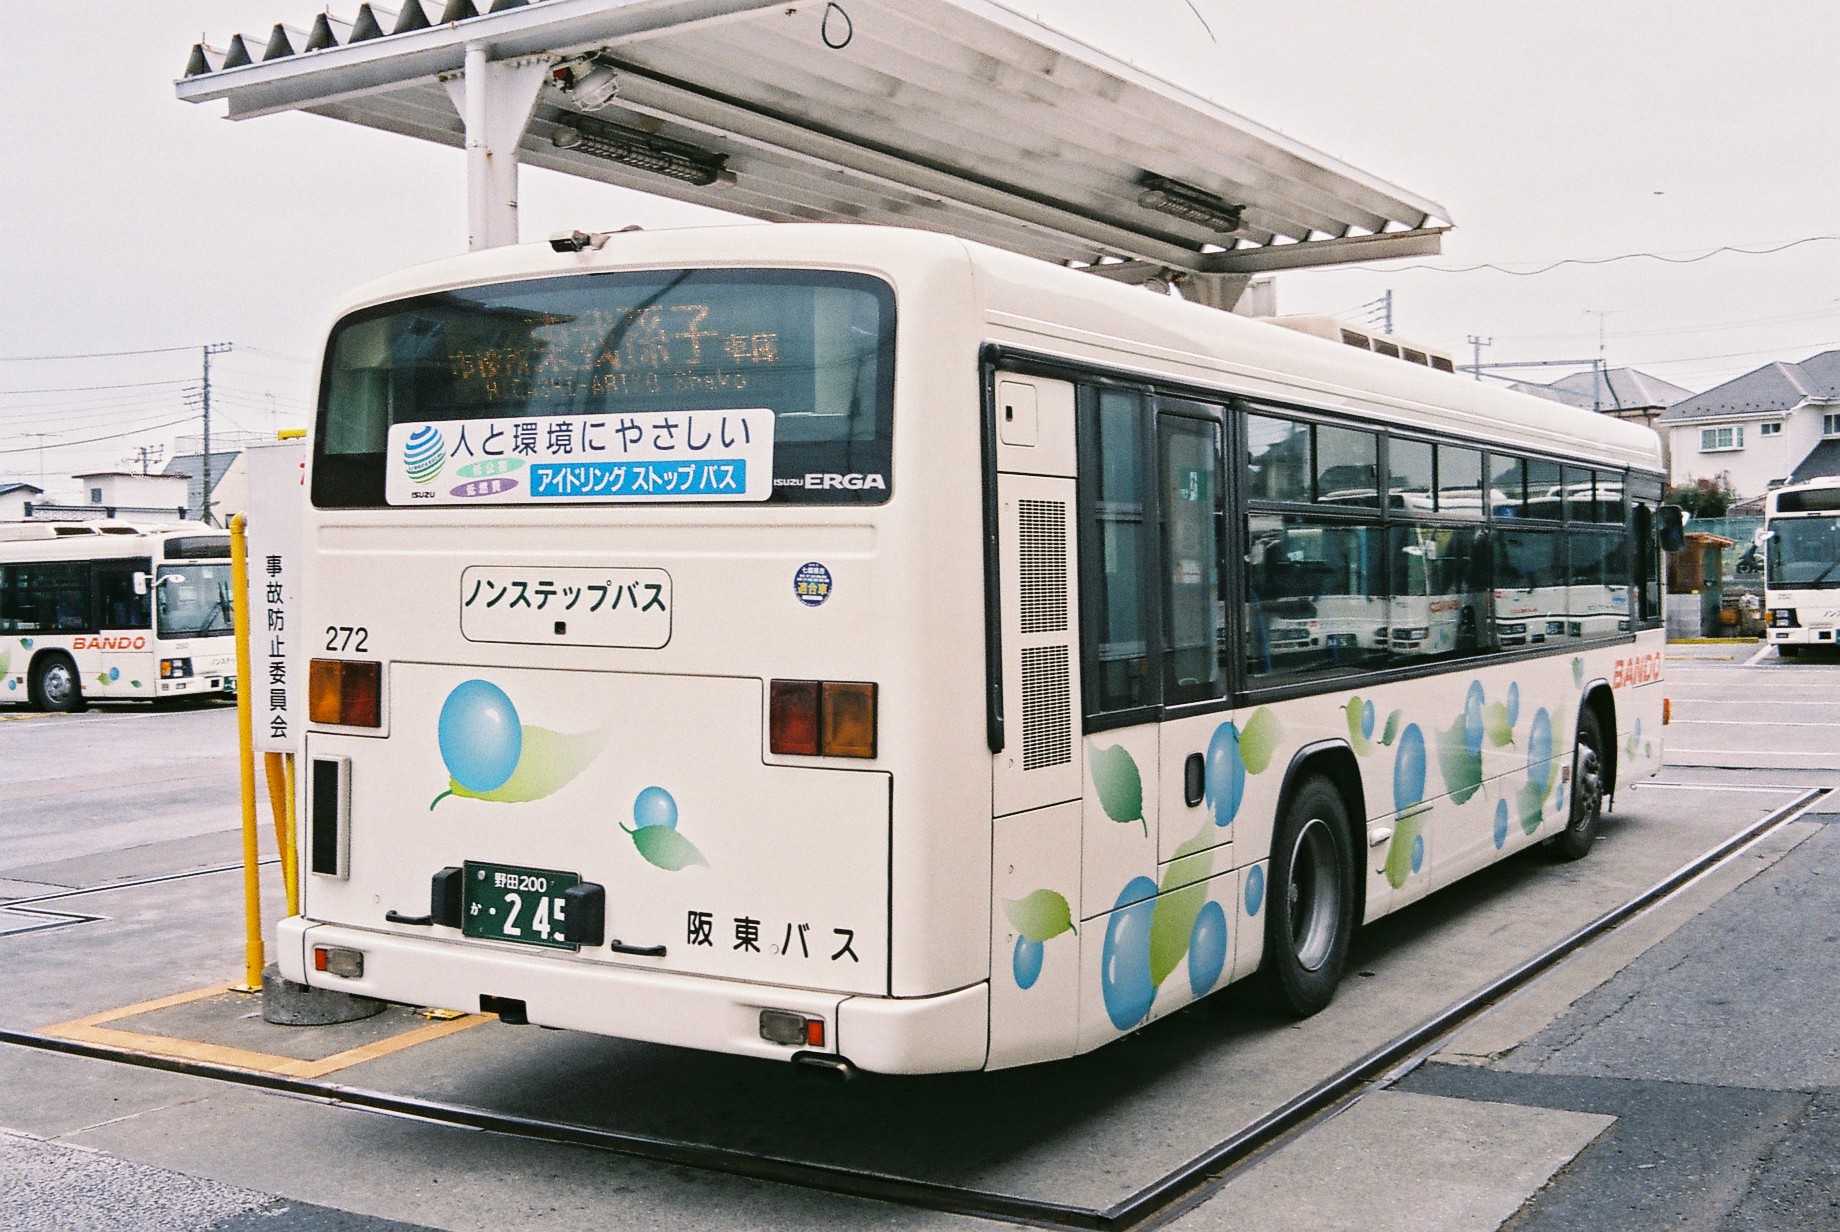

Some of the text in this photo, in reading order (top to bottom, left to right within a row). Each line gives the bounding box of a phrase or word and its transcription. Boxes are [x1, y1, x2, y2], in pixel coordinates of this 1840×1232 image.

[450, 415, 751, 458] 人と環境にやさしい
[411, 491, 436, 499] ISUZU
[773, 473, 886, 490] ISUZU ERGA
[465, 579, 667, 613] ノンステップバス
[72, 636, 147, 651] BANDO
[265, 554, 289, 740] 事故防止委員会
[324, 626, 369, 653] 272
[1612, 651, 1661, 689] BANDO
[494, 872, 547, 893] 野田200
[470, 902, 482, 916] か
[687, 910, 860, 963] 阪東バス
